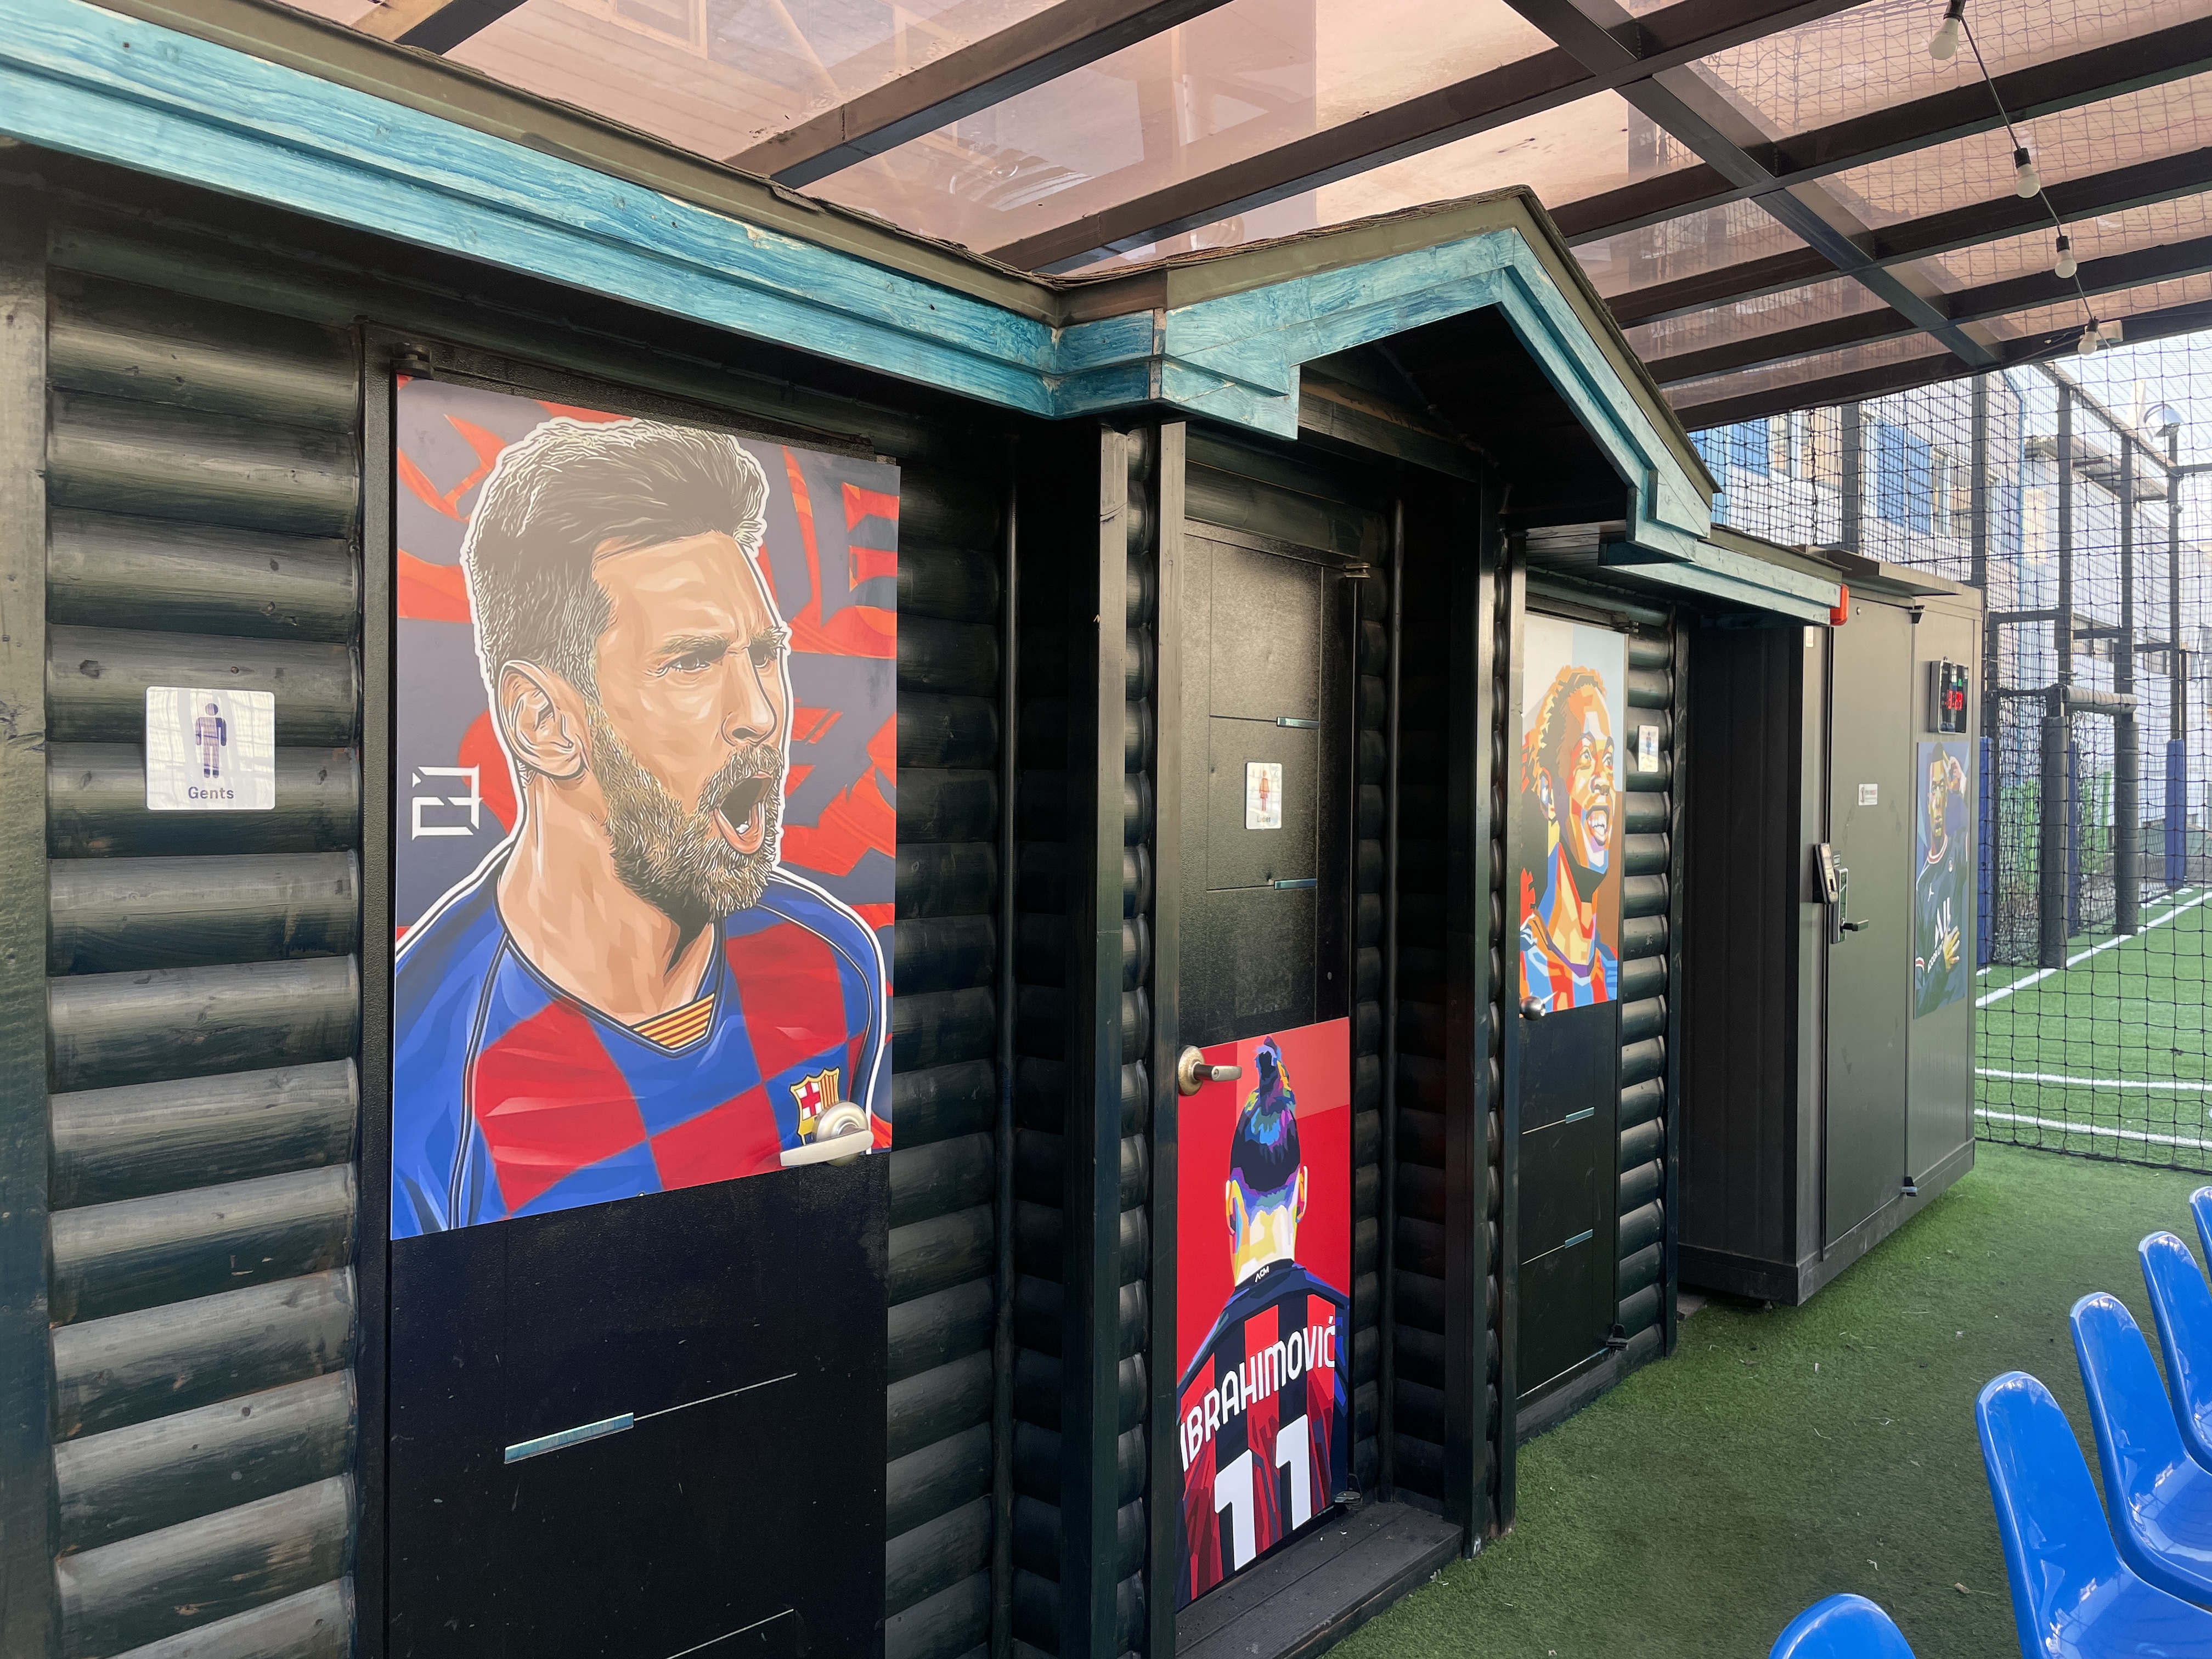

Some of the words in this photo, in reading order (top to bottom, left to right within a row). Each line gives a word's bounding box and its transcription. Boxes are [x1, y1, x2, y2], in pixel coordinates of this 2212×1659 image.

[189, 786, 234, 799] Gents
[1180, 1316, 1335, 1472] IBRAHIMOVIĆ
[1214, 1414, 1312, 1571] 11
